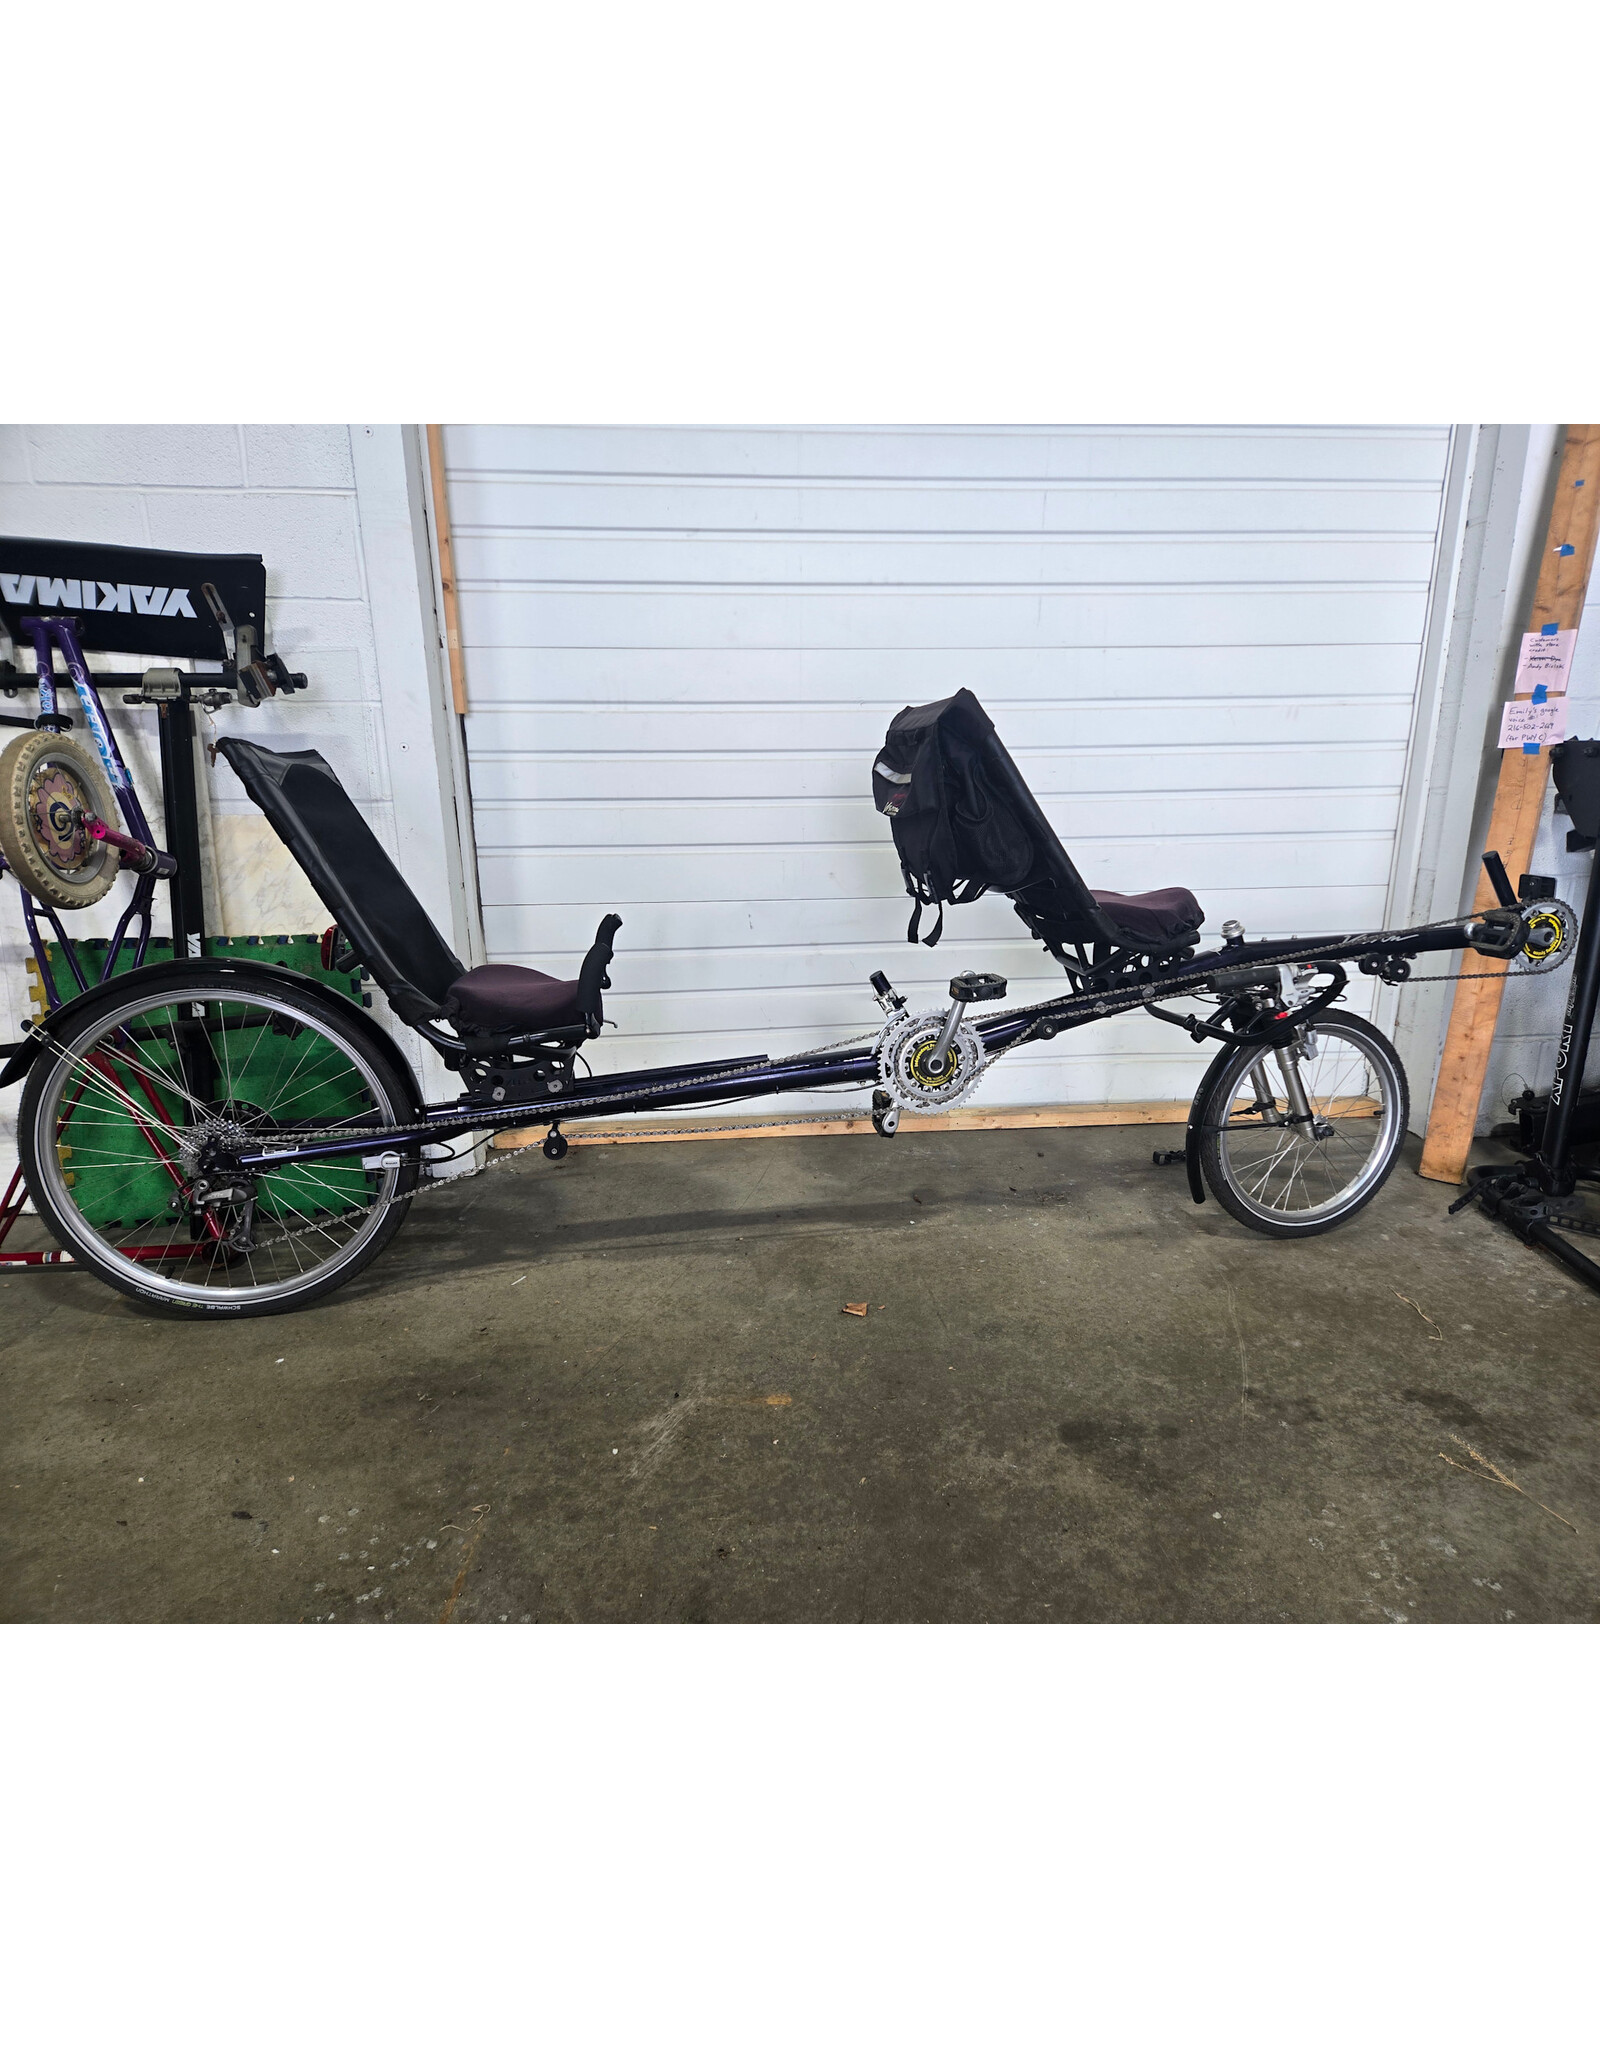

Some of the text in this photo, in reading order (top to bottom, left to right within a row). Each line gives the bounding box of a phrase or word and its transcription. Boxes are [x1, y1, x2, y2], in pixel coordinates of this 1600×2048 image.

[0, 573, 198, 619] YAKIMA
[1508, 706, 1560, 717] Emily's google
